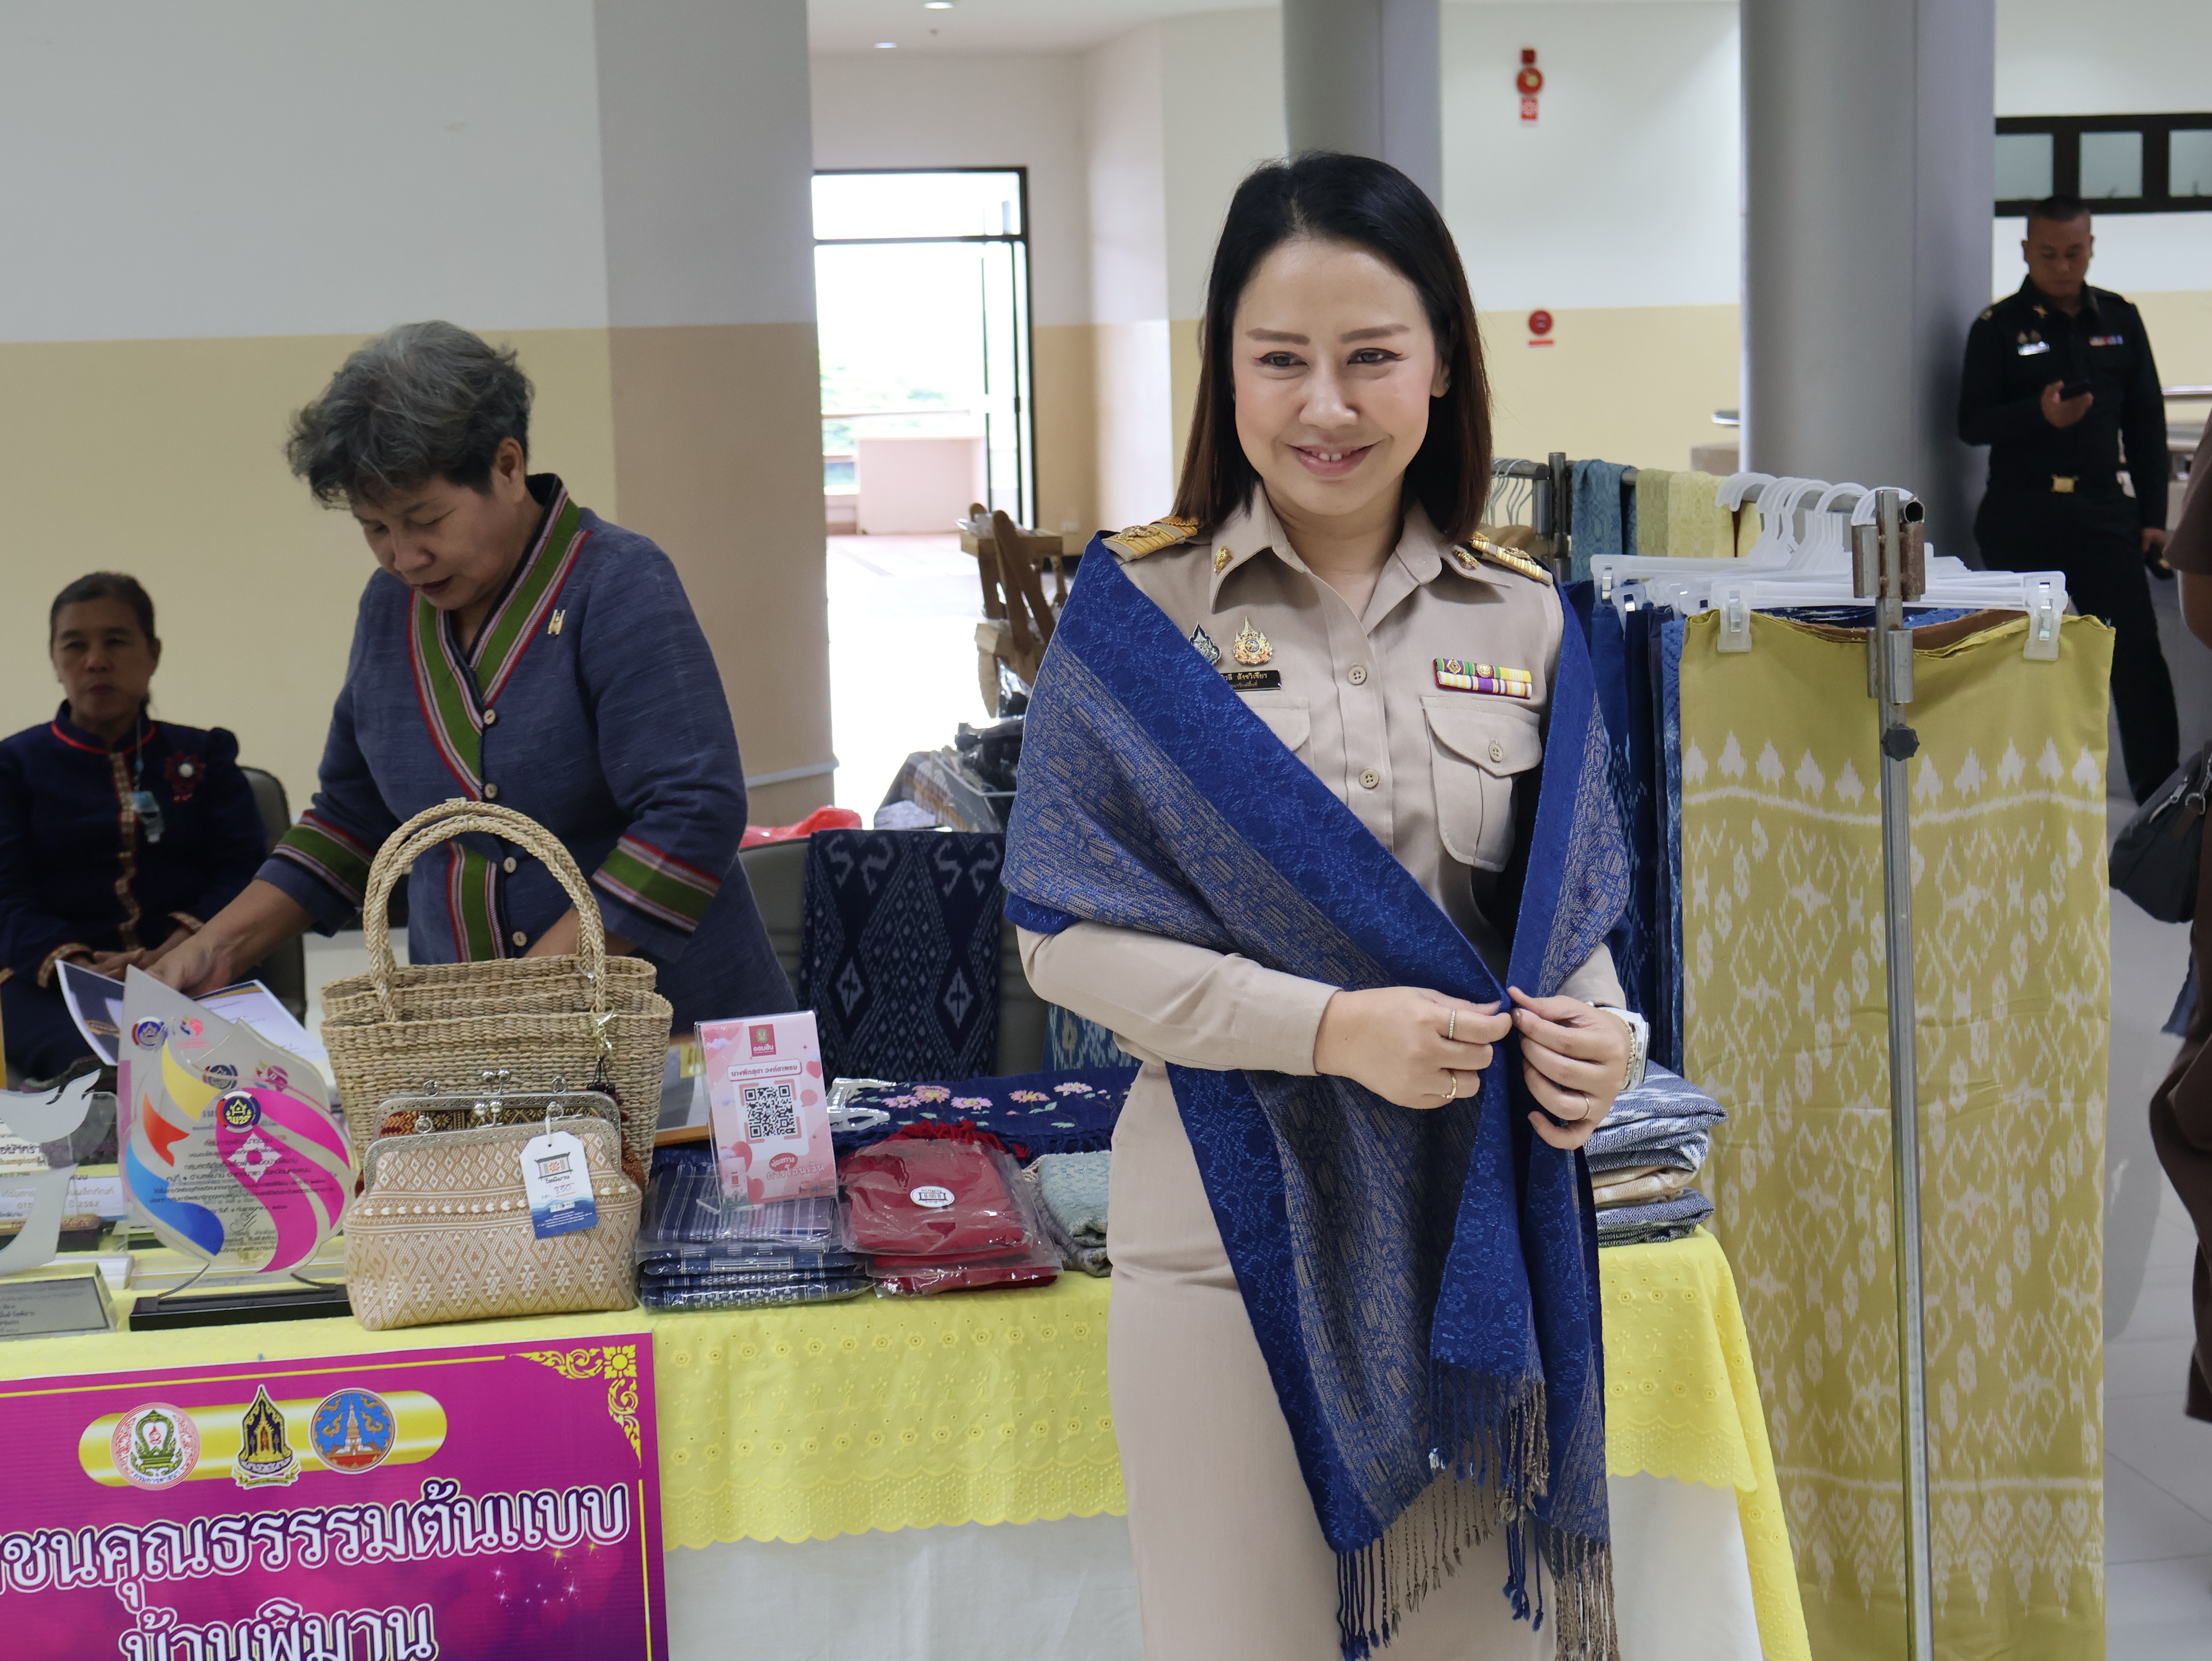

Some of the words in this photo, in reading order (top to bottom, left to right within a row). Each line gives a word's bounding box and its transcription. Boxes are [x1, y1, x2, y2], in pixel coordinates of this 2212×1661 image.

[753, 1044, 774, 1052] ออมสิน
[0, 1480, 630, 1612] ชนคุณธรรรมต้นแบบ
[120, 1599, 439, 1661] บ้านพิมาน
